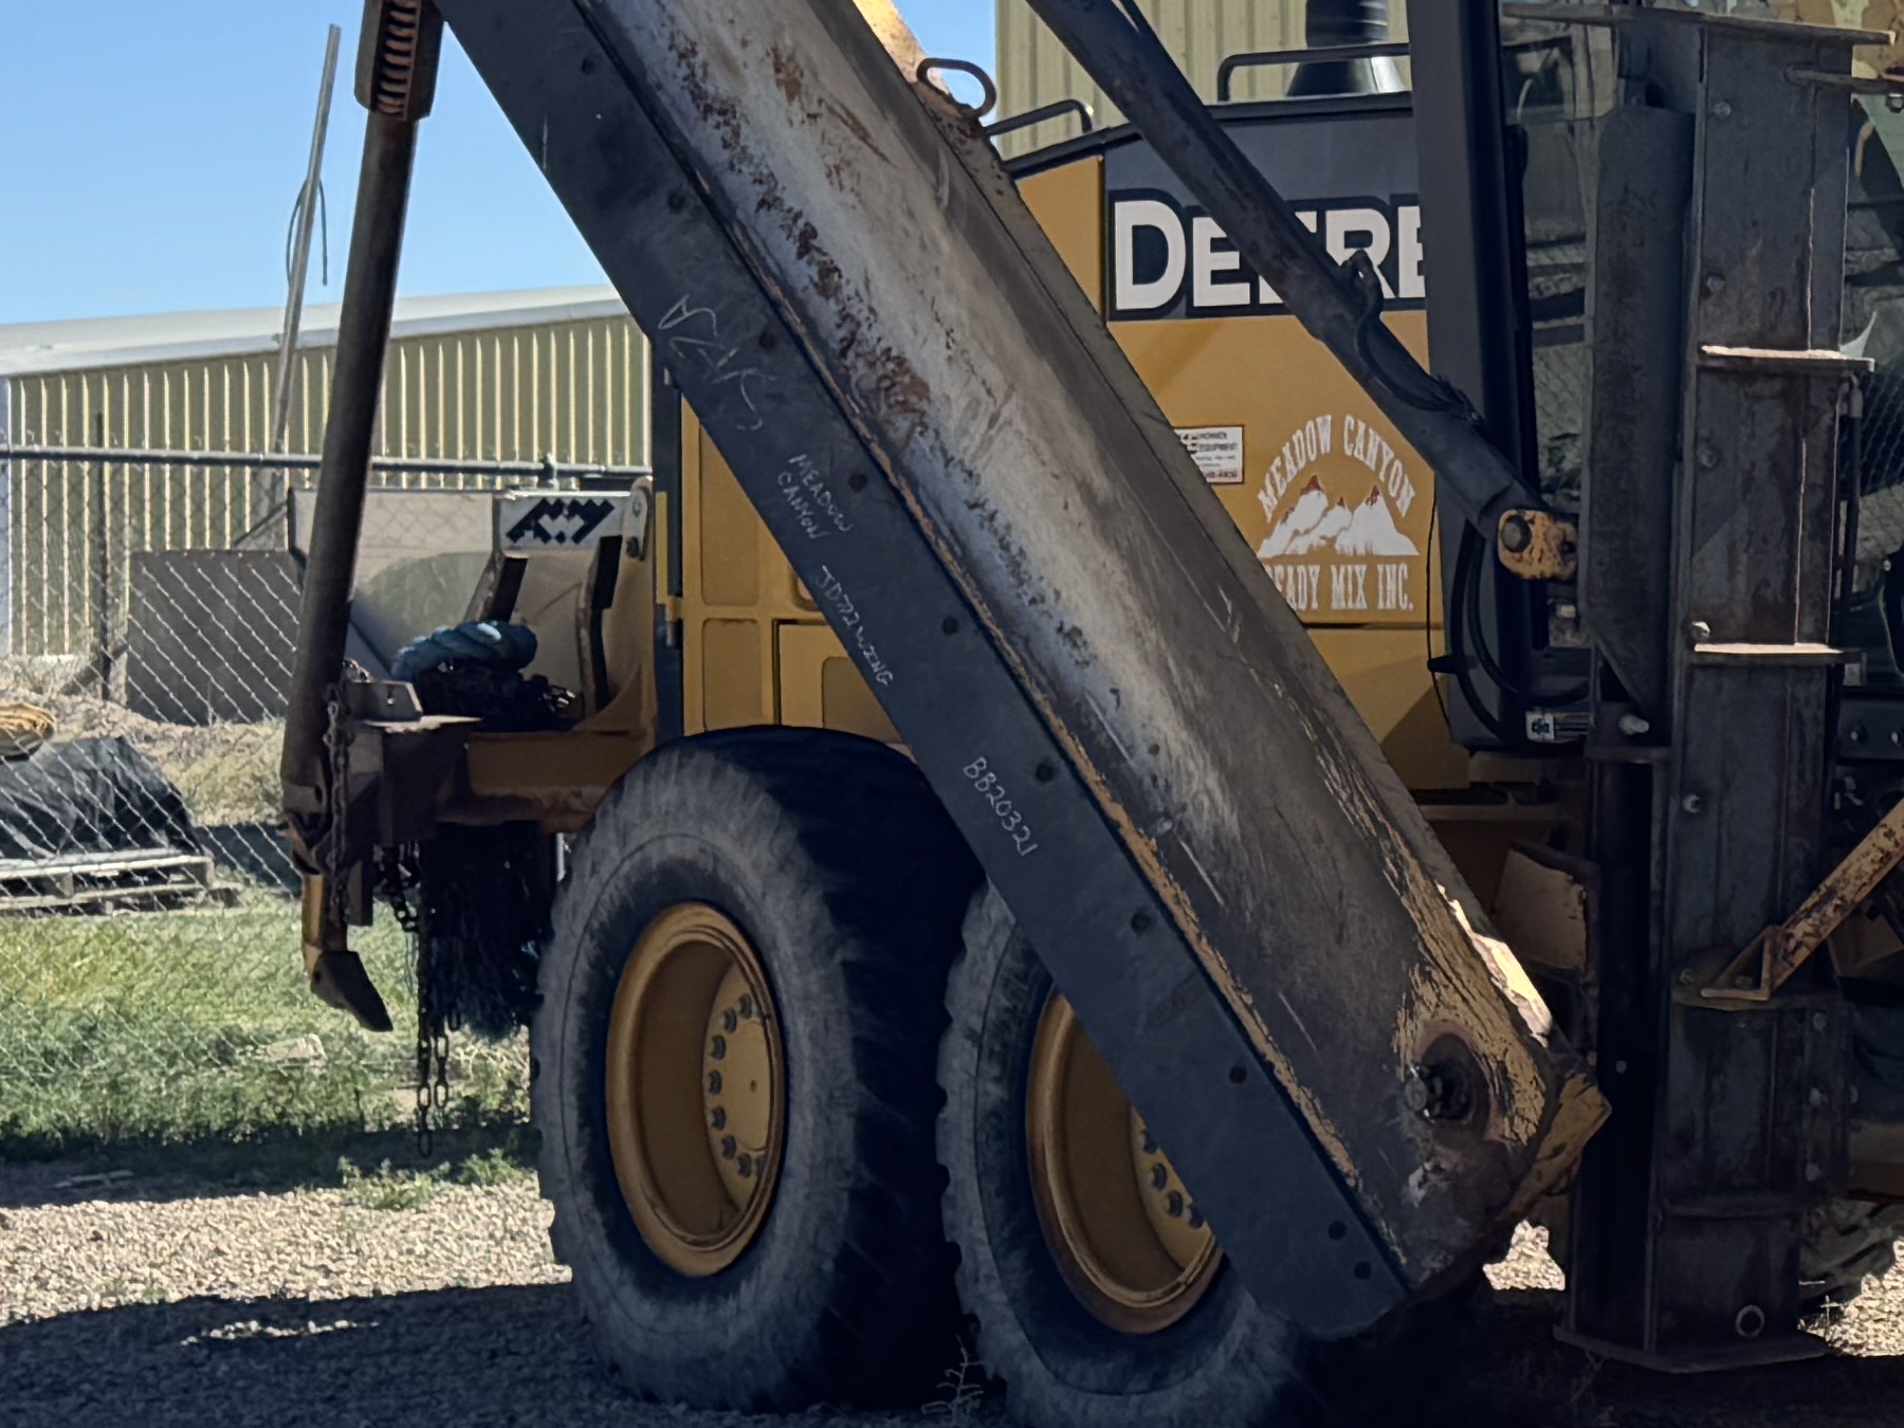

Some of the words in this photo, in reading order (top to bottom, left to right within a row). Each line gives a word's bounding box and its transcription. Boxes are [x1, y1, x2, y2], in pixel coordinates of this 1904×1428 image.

[1114, 199, 1426, 311] DERE
[1258, 414, 1331, 523] MEADOW
[1343, 414, 1415, 518] CANYON
[1330, 564, 1367, 611] MIX
[1377, 563, 1414, 611] INC.
[963, 756, 1039, 857] BB20321
